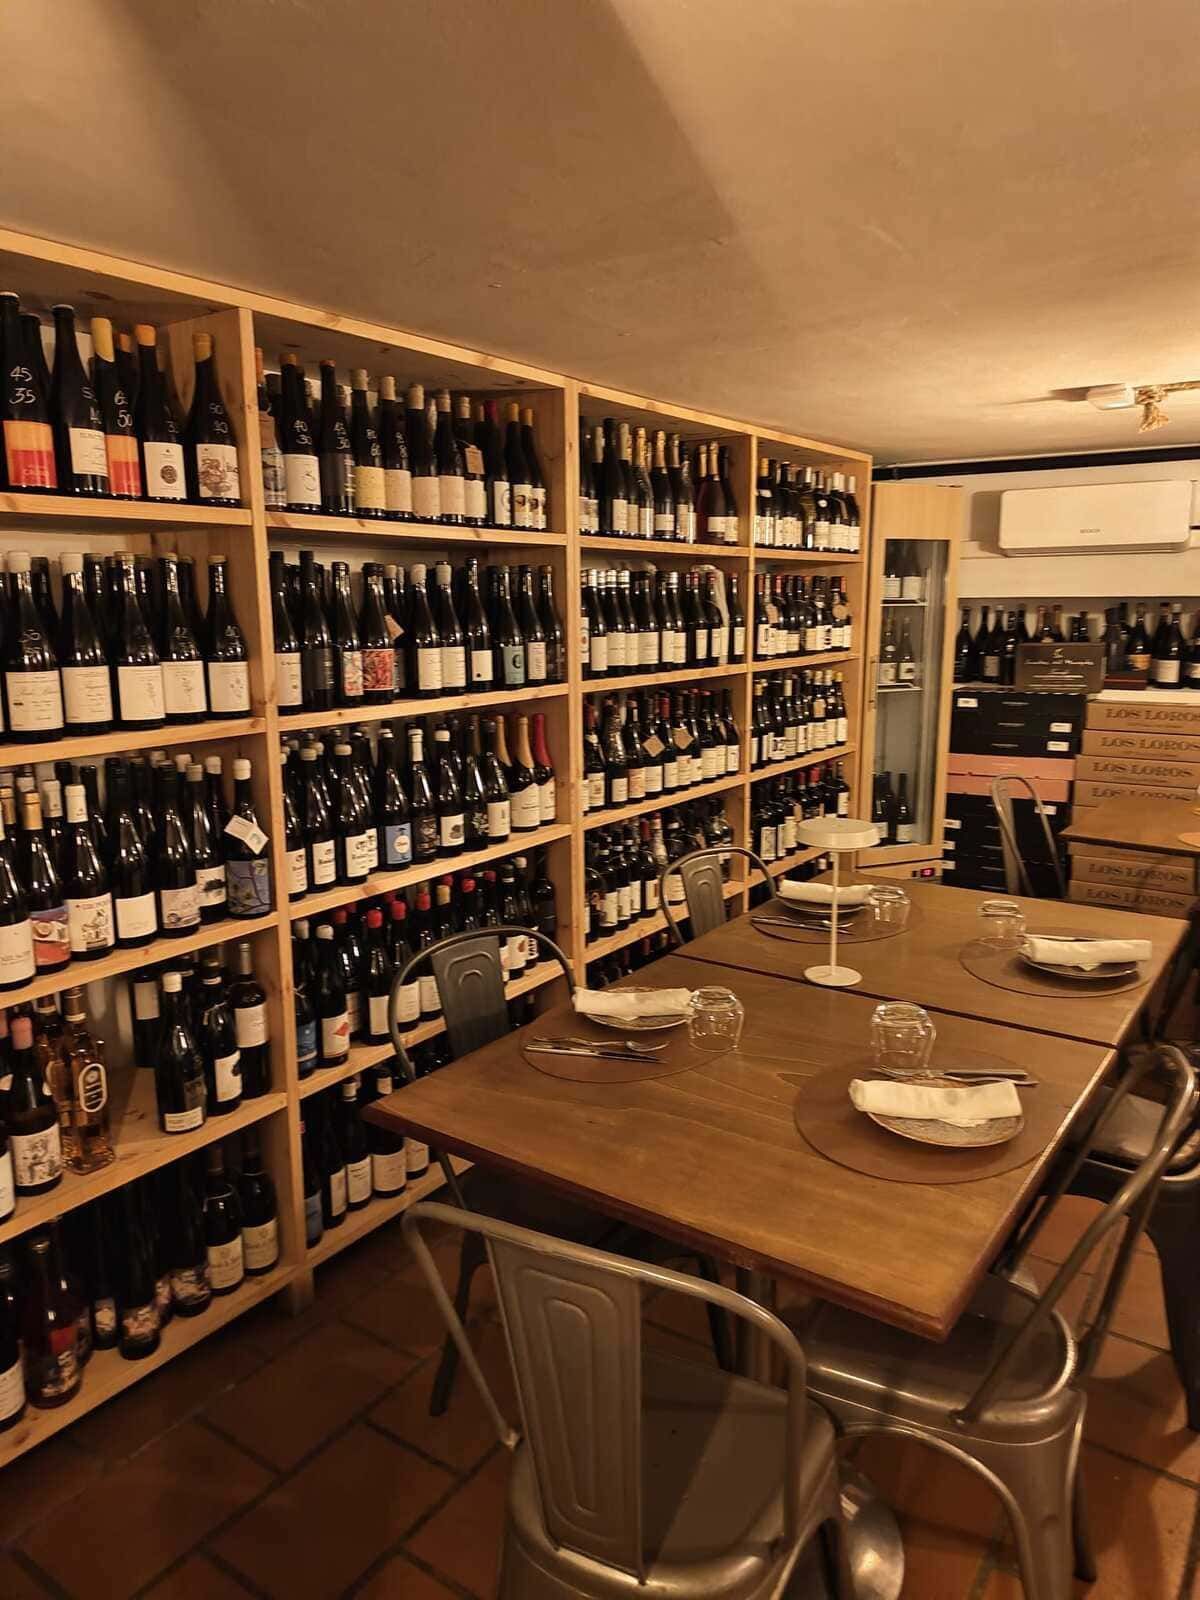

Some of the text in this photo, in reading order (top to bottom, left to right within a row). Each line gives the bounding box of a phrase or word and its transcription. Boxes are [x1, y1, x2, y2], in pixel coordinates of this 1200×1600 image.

[10, 366, 33, 382] 45
[8, 387, 37, 404] 35
[1104, 708, 1141, 720] LOS
[1101, 736, 1137, 747] LOS
[1092, 762, 1194, 778] LOS LOROS
